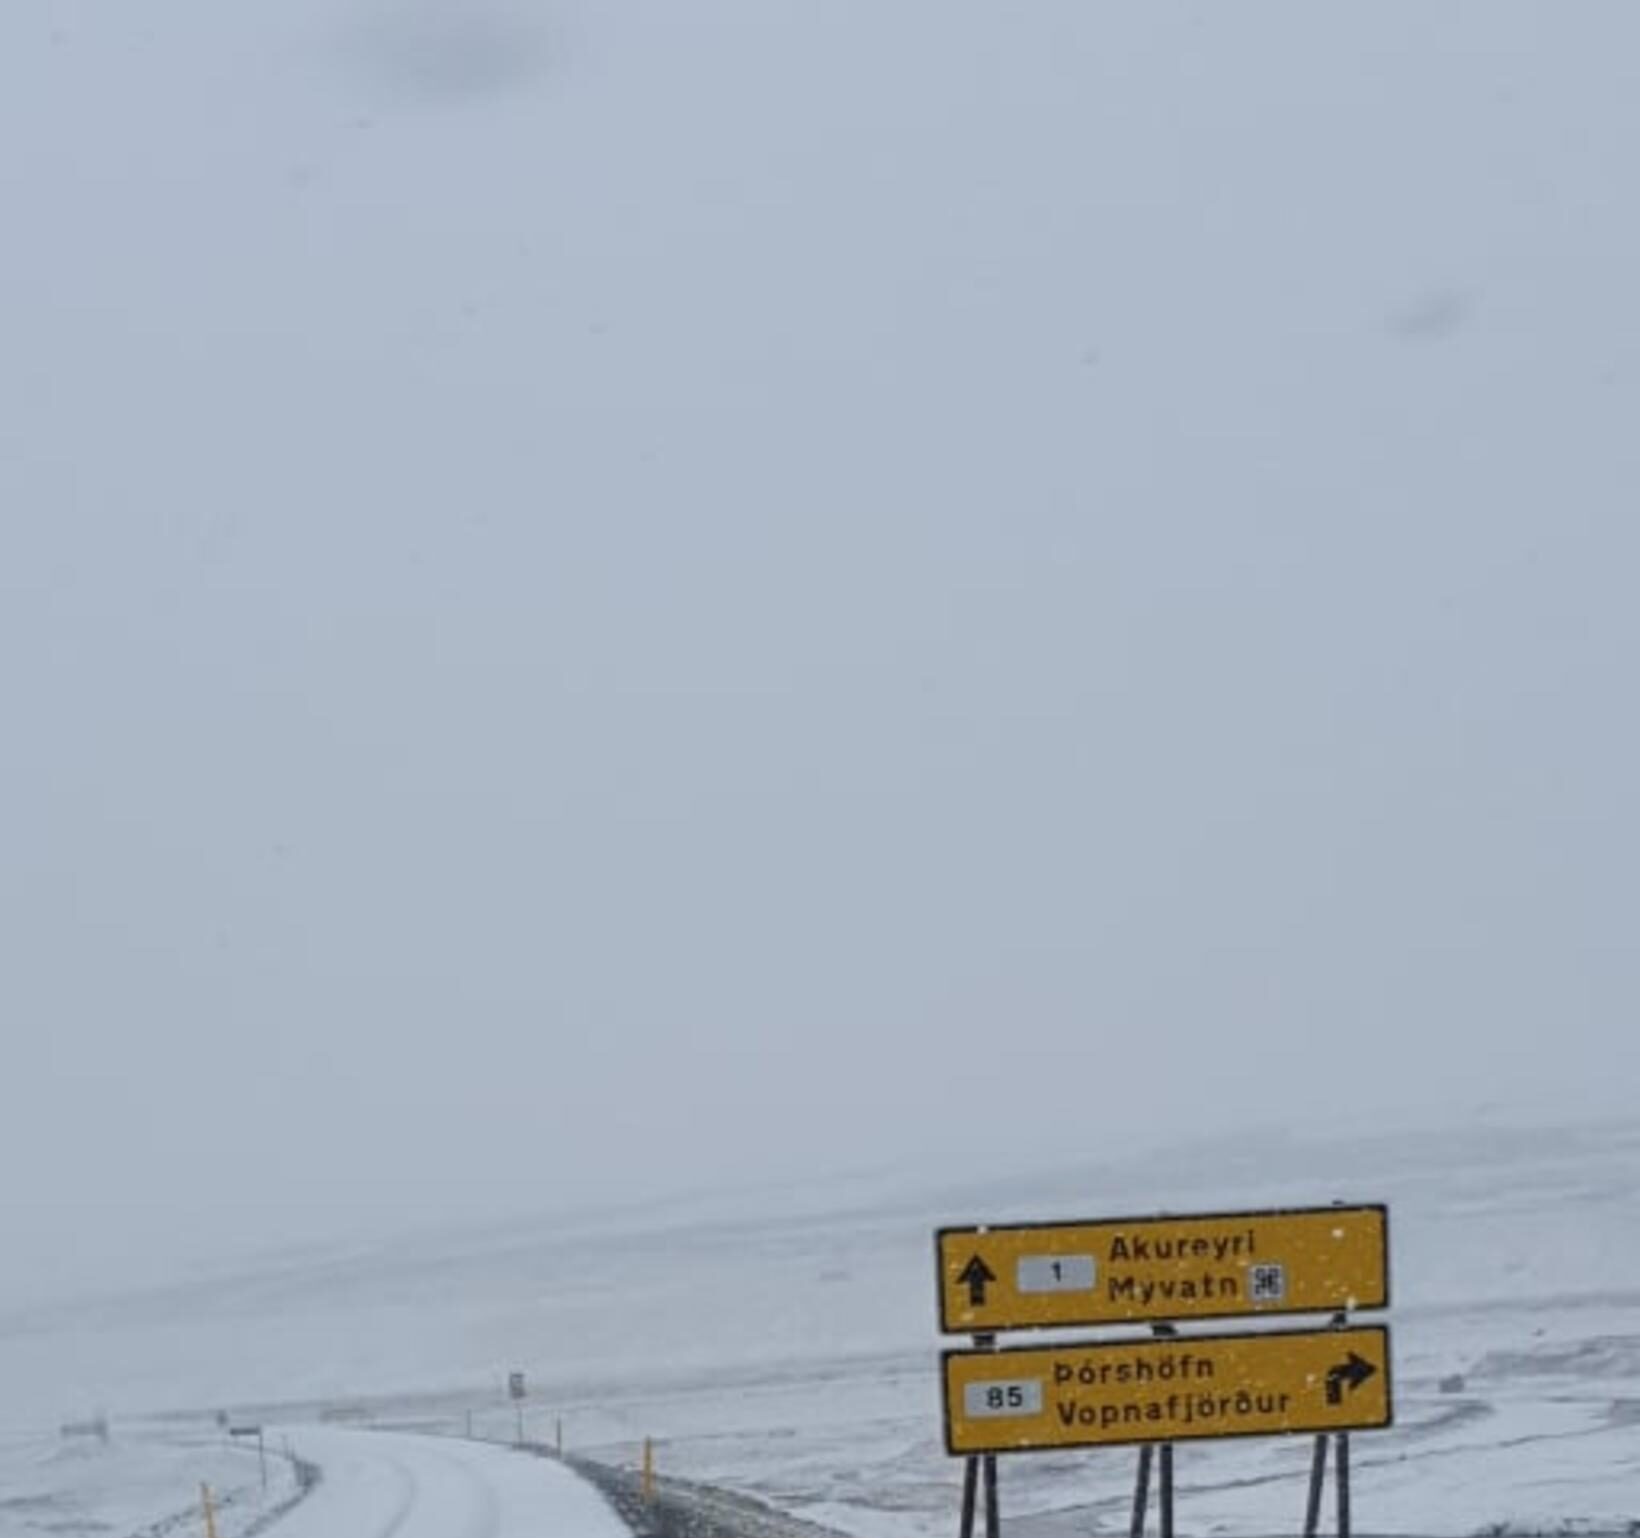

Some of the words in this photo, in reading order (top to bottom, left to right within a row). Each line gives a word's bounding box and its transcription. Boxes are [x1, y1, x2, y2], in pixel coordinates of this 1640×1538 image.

[1110, 1230, 1255, 1262] Akureyri
[1052, 1262, 1061, 1282] 1
[1054, 1355, 1214, 1387] Þórshöfn
[986, 1386, 1023, 1409] 85
[1057, 1391, 1290, 1429] Vopnafjörður
